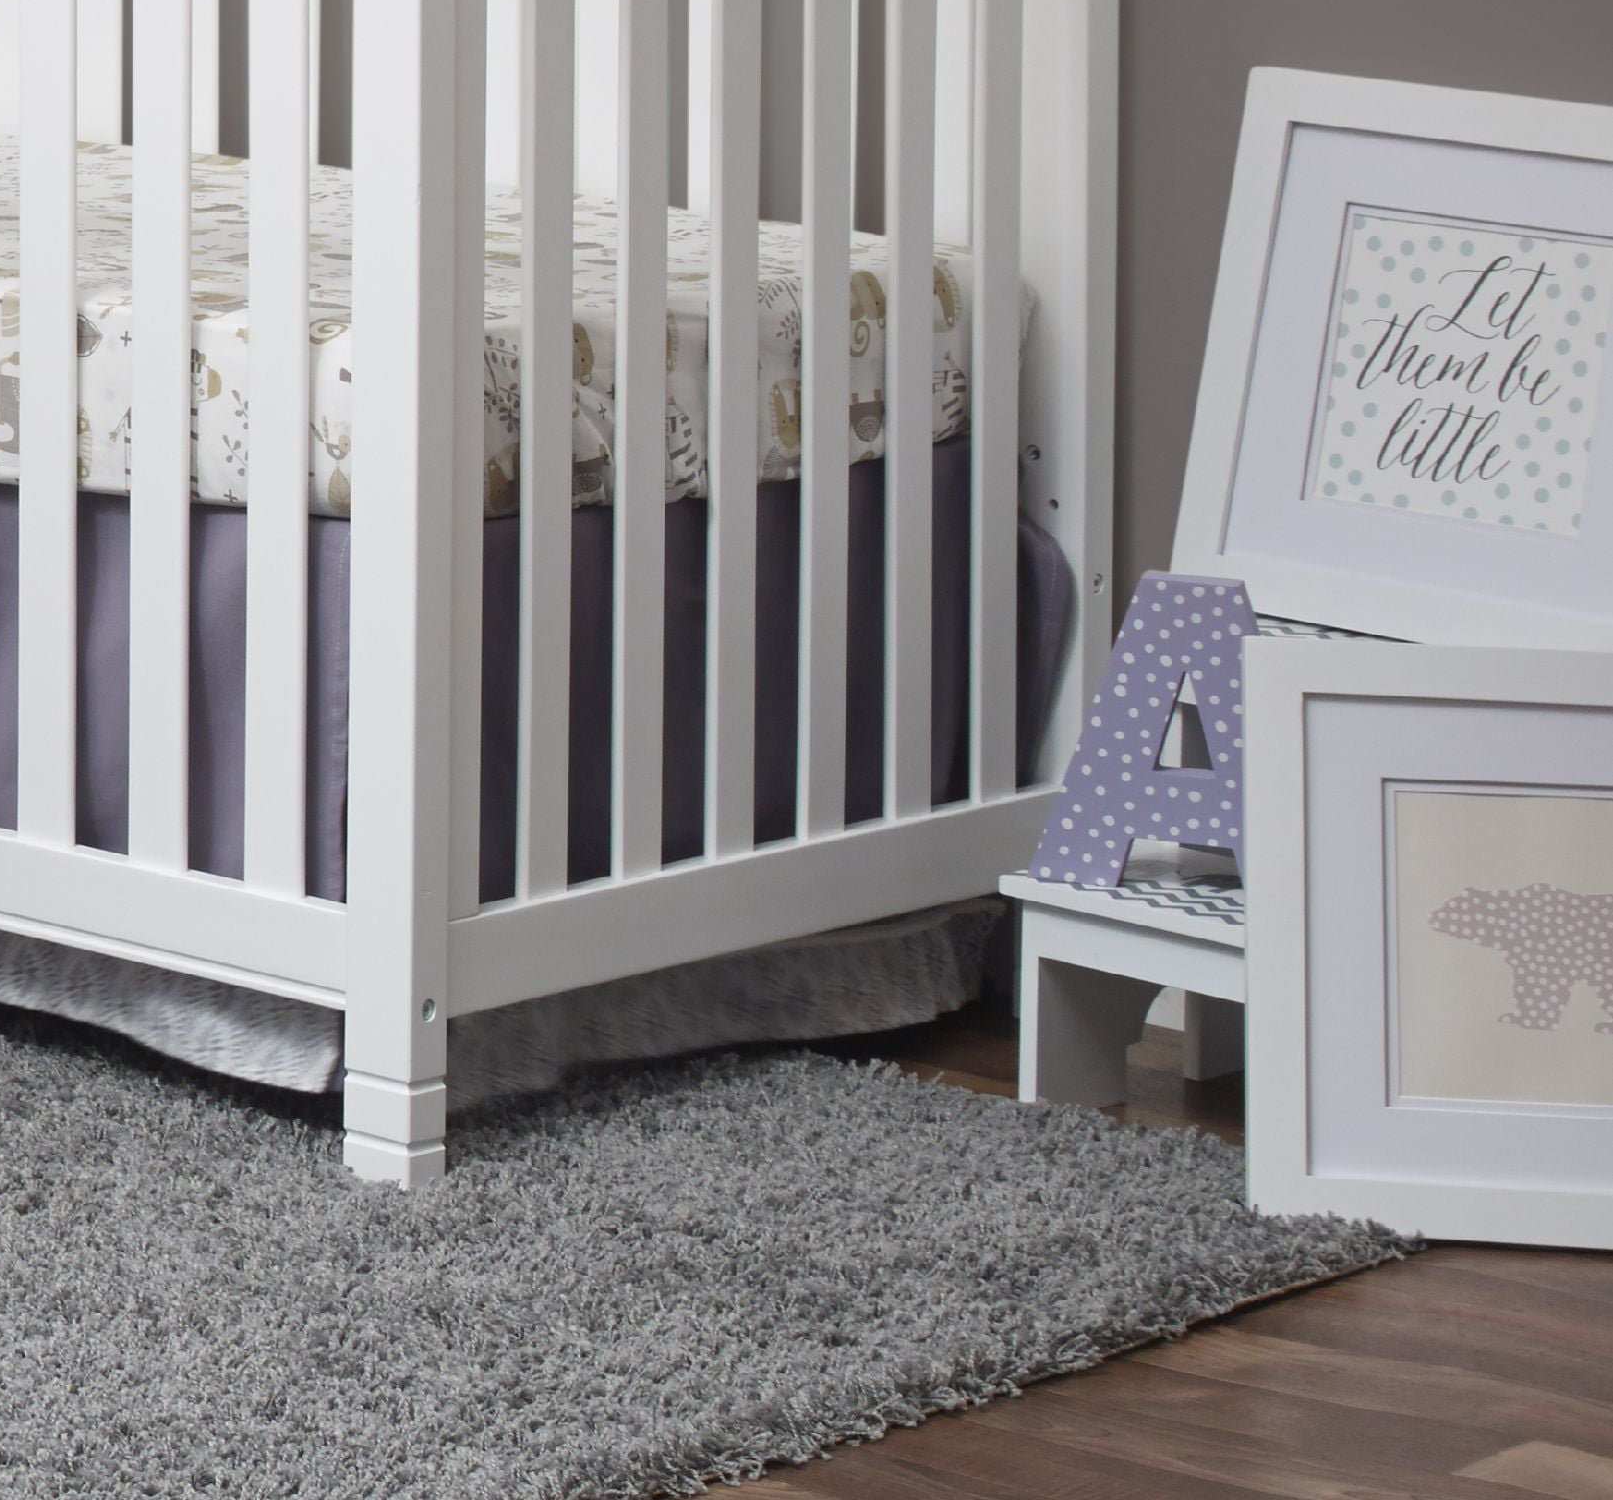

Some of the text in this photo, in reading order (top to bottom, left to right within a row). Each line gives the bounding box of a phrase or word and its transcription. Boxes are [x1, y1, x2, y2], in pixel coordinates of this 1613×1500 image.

[1426, 256, 1556, 339] Let
[1356, 304, 1561, 406] them be
[1377, 398, 1510, 483] little
[1028, 570, 1258, 887] A
